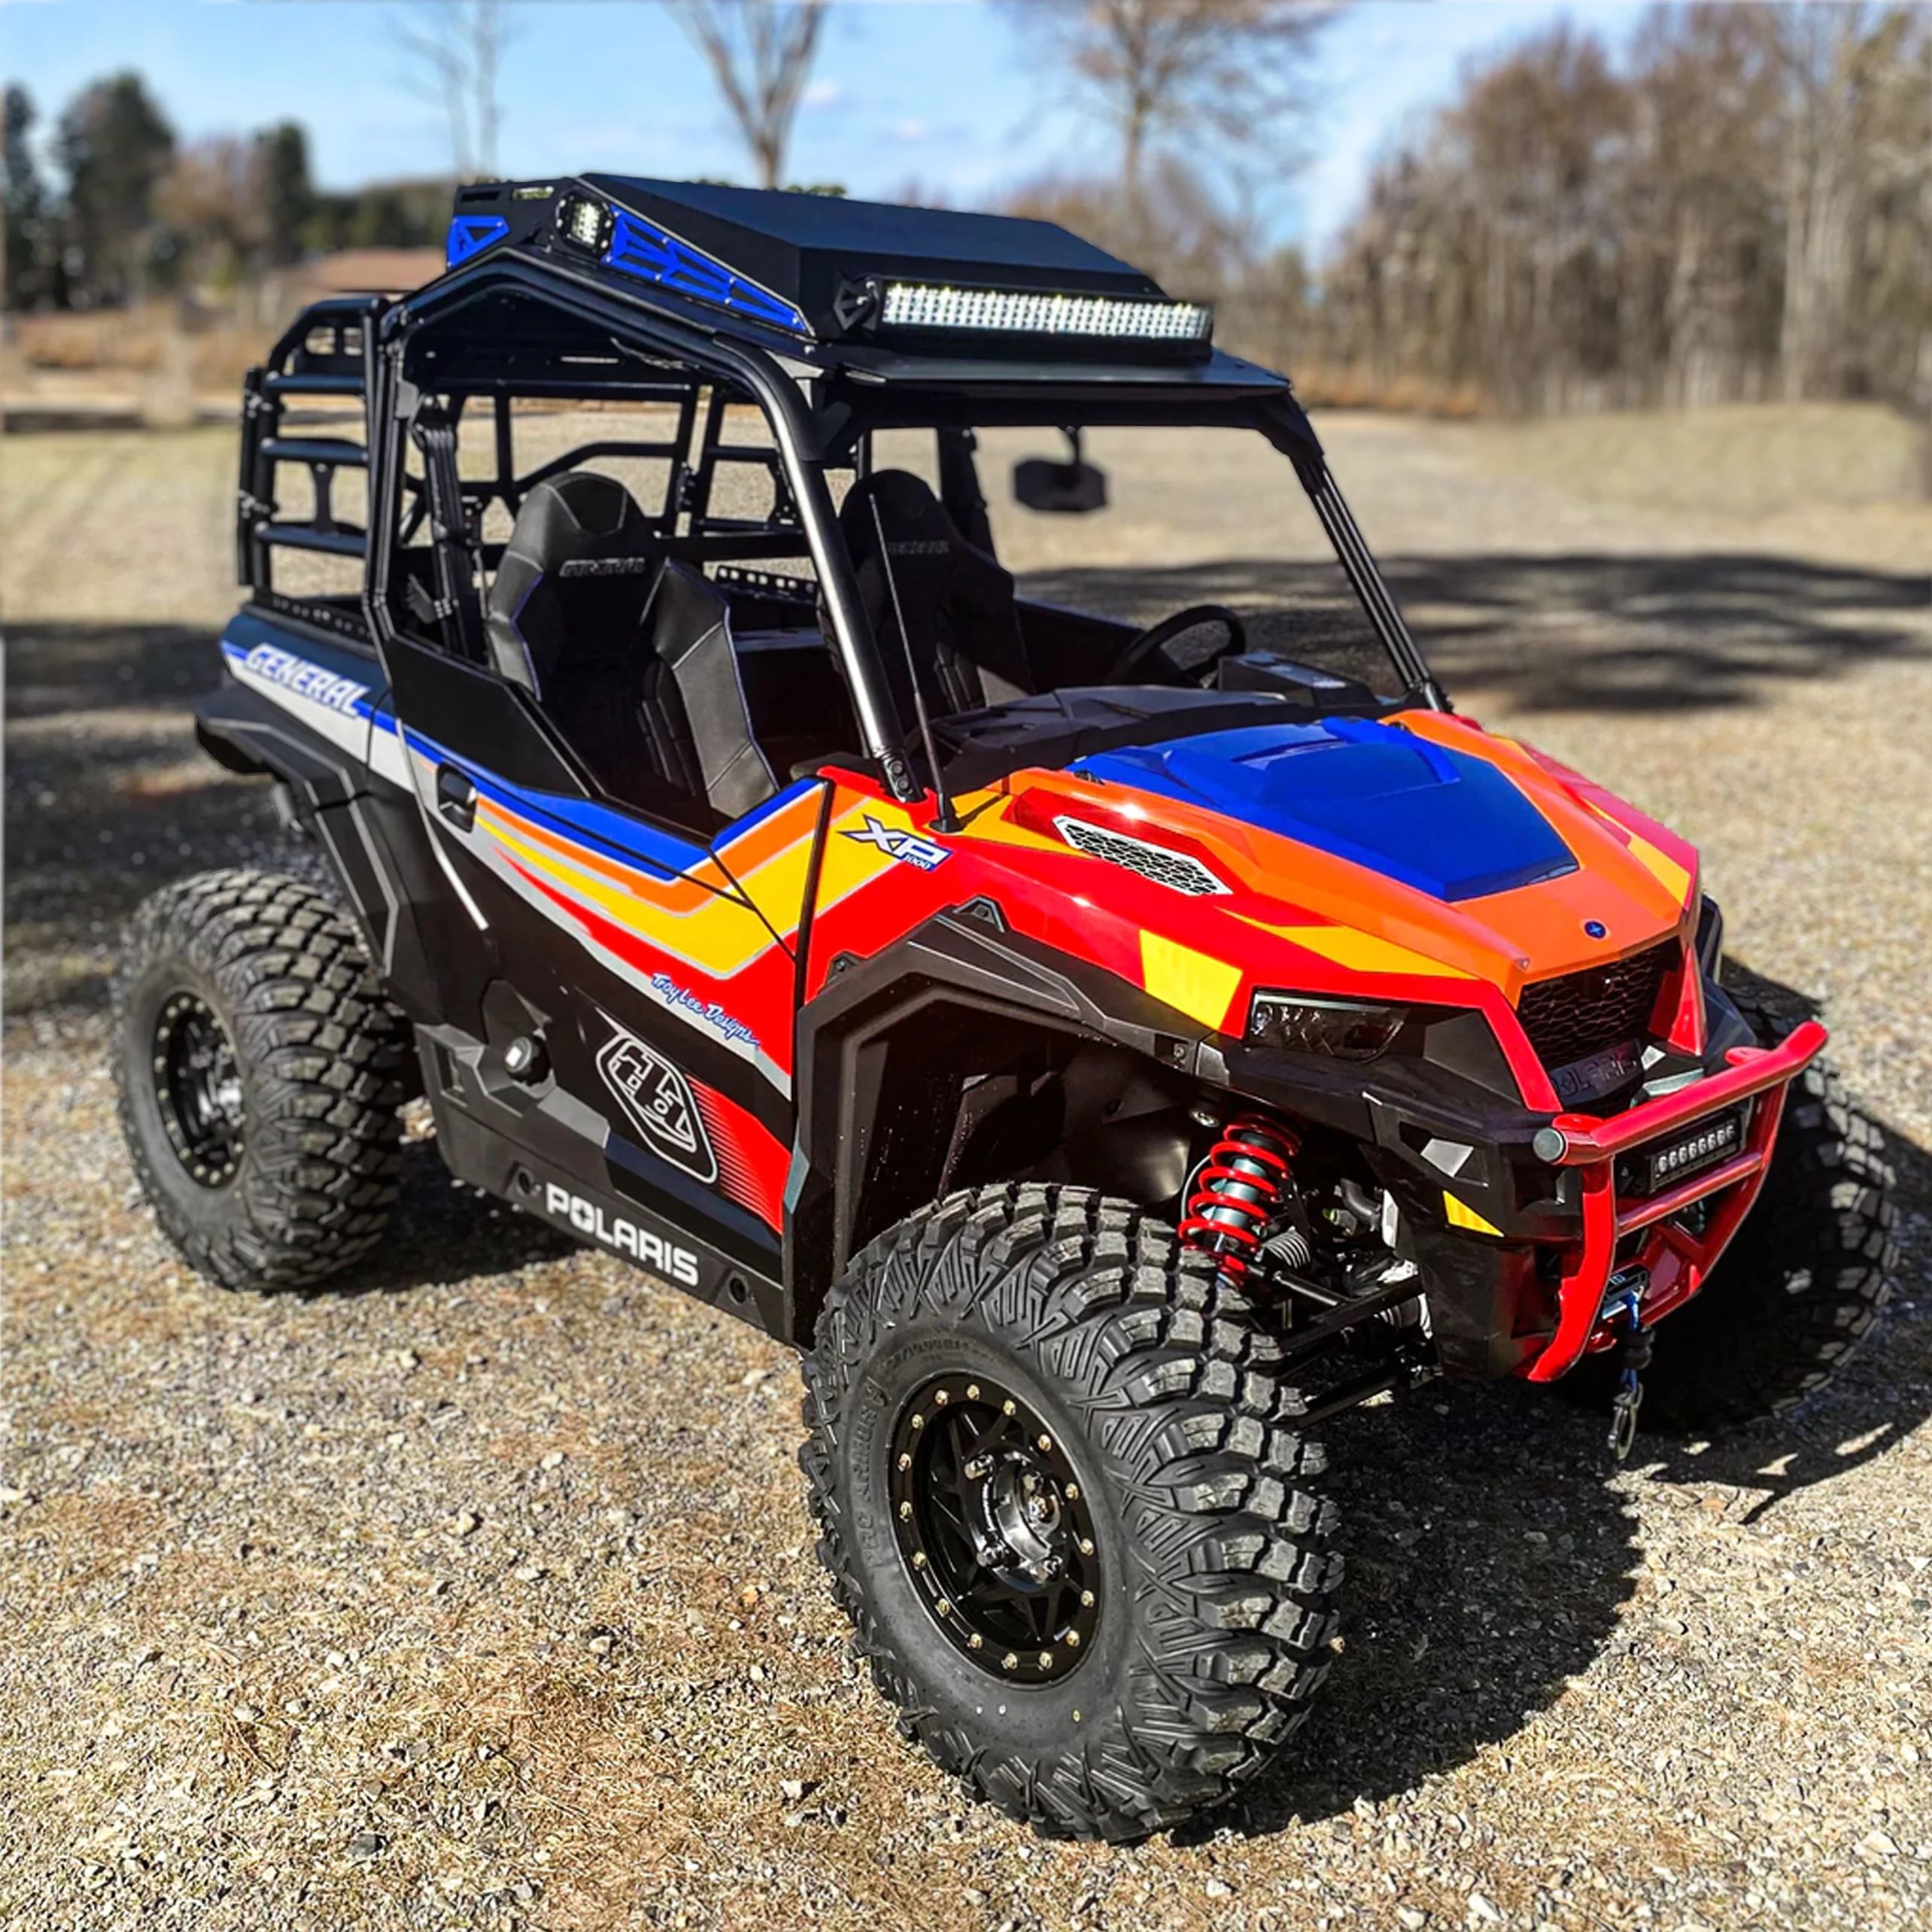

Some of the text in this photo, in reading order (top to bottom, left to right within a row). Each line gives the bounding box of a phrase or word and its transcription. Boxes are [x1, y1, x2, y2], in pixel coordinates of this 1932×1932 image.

[245, 642, 370, 719] GENERAL
[837, 814, 954, 867] XP
[651, 972, 761, 1049] Troy Lee Designs
[545, 1181, 699, 1286] POLARIS
